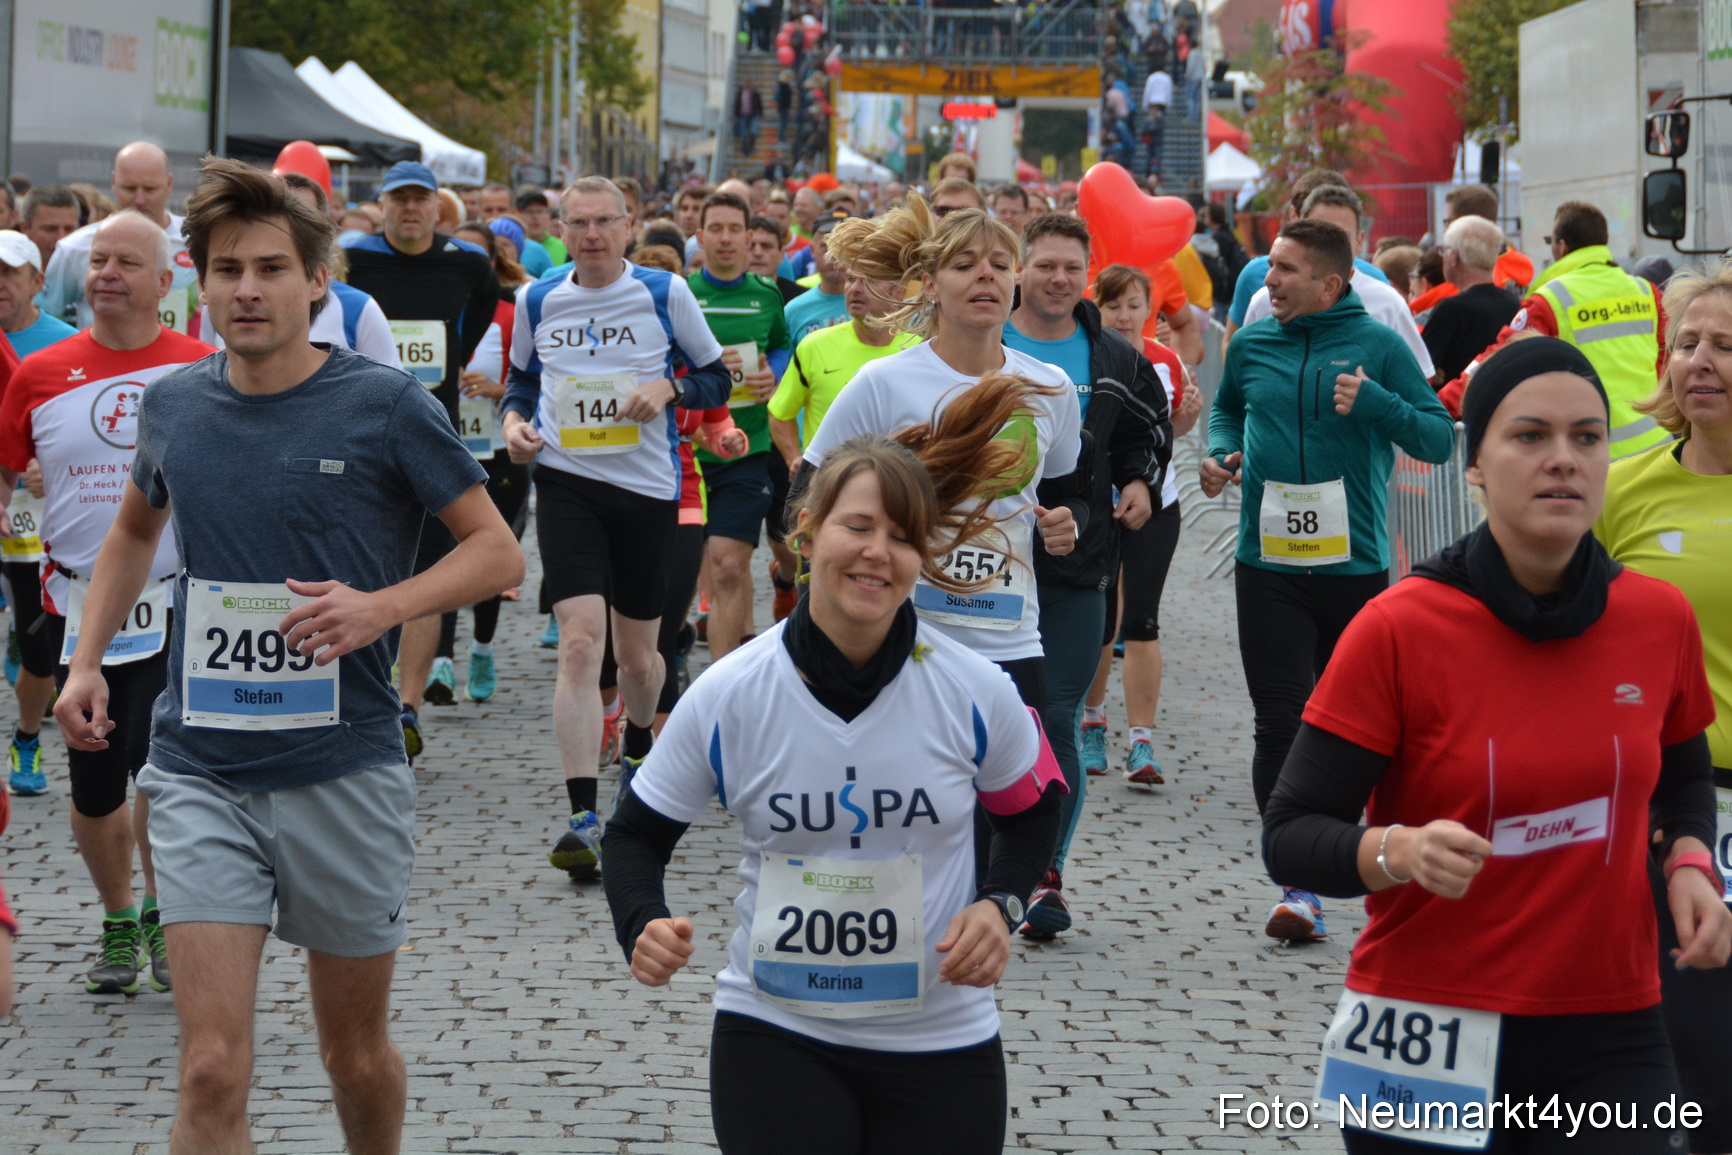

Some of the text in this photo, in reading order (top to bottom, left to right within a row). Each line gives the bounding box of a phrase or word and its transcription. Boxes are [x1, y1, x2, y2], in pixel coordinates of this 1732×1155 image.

[942, 70, 999, 92] ZIEL
[550, 322, 637, 350] SUSPA
[396, 342, 434, 363] 165
[575, 398, 618, 423] 144
[589, 431, 607, 441] Rolf
[68, 465, 116, 477] LAUFEN
[79, 481, 92, 490] Dr.
[93, 480, 117, 489] Heck
[1287, 510, 1319, 535] 58
[1287, 542, 1320, 552] Steffen
[237, 597, 291, 610] BOCK
[946, 593, 995, 610] Susanne
[192, 662, 198, 670] D
[234, 687, 283, 705] Stefan
[768, 777, 940, 838] SUSPA
[1524, 816, 1577, 843] DEHN
[816, 873, 875, 889] BOCK
[774, 905, 898, 957] 2069
[758, 944, 764, 953] D
[807, 972, 863, 990] Karina
[1344, 1001, 1461, 1071] 2481
[1376, 1080, 1414, 1105] Anja
